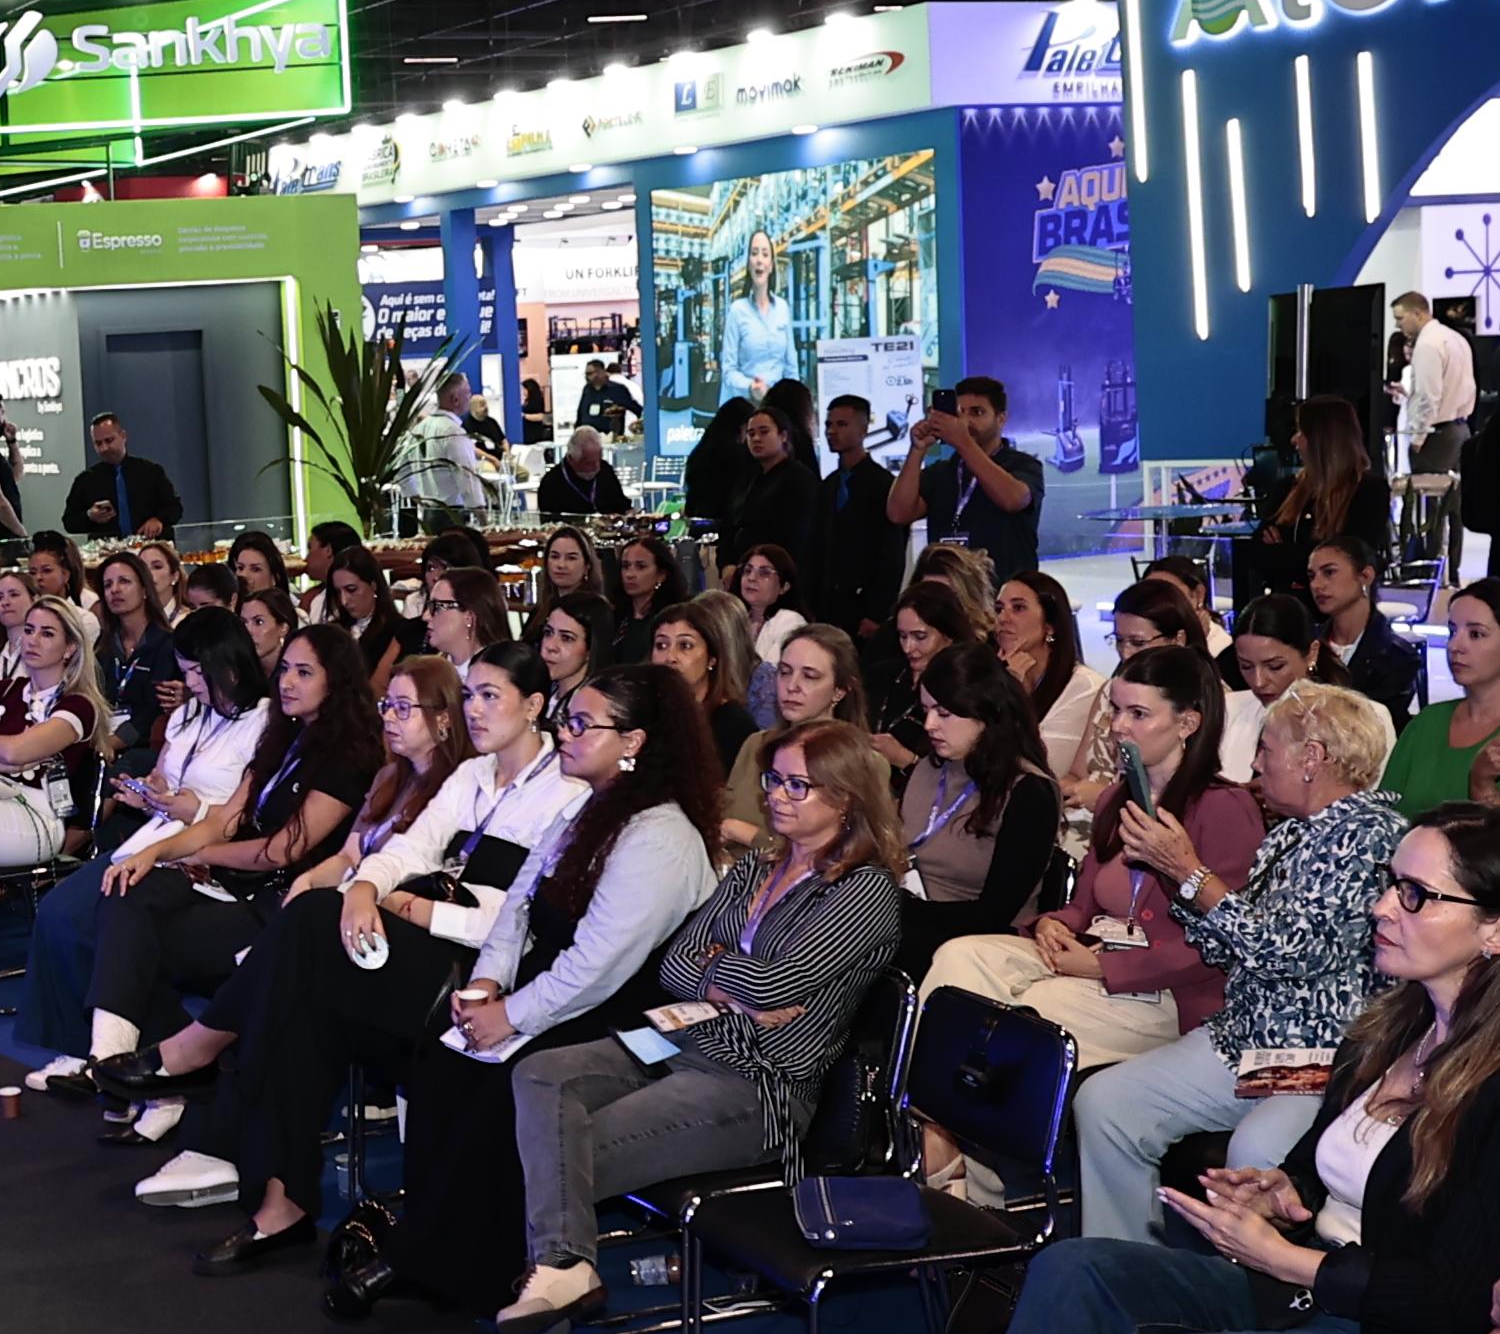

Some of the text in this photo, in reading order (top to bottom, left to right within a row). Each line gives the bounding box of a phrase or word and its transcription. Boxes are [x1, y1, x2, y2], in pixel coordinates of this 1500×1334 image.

[72, 14, 329, 74] Sankhya
[92, 231, 163, 251] Espresso
[380, 293, 404, 307] Aqui
[405, 292, 412, 305] é
[413, 294, 434, 305] sem
[377, 307, 390, 324] O
[402, 326, 432, 342] eças
[870, 340, 915, 353] TE21
